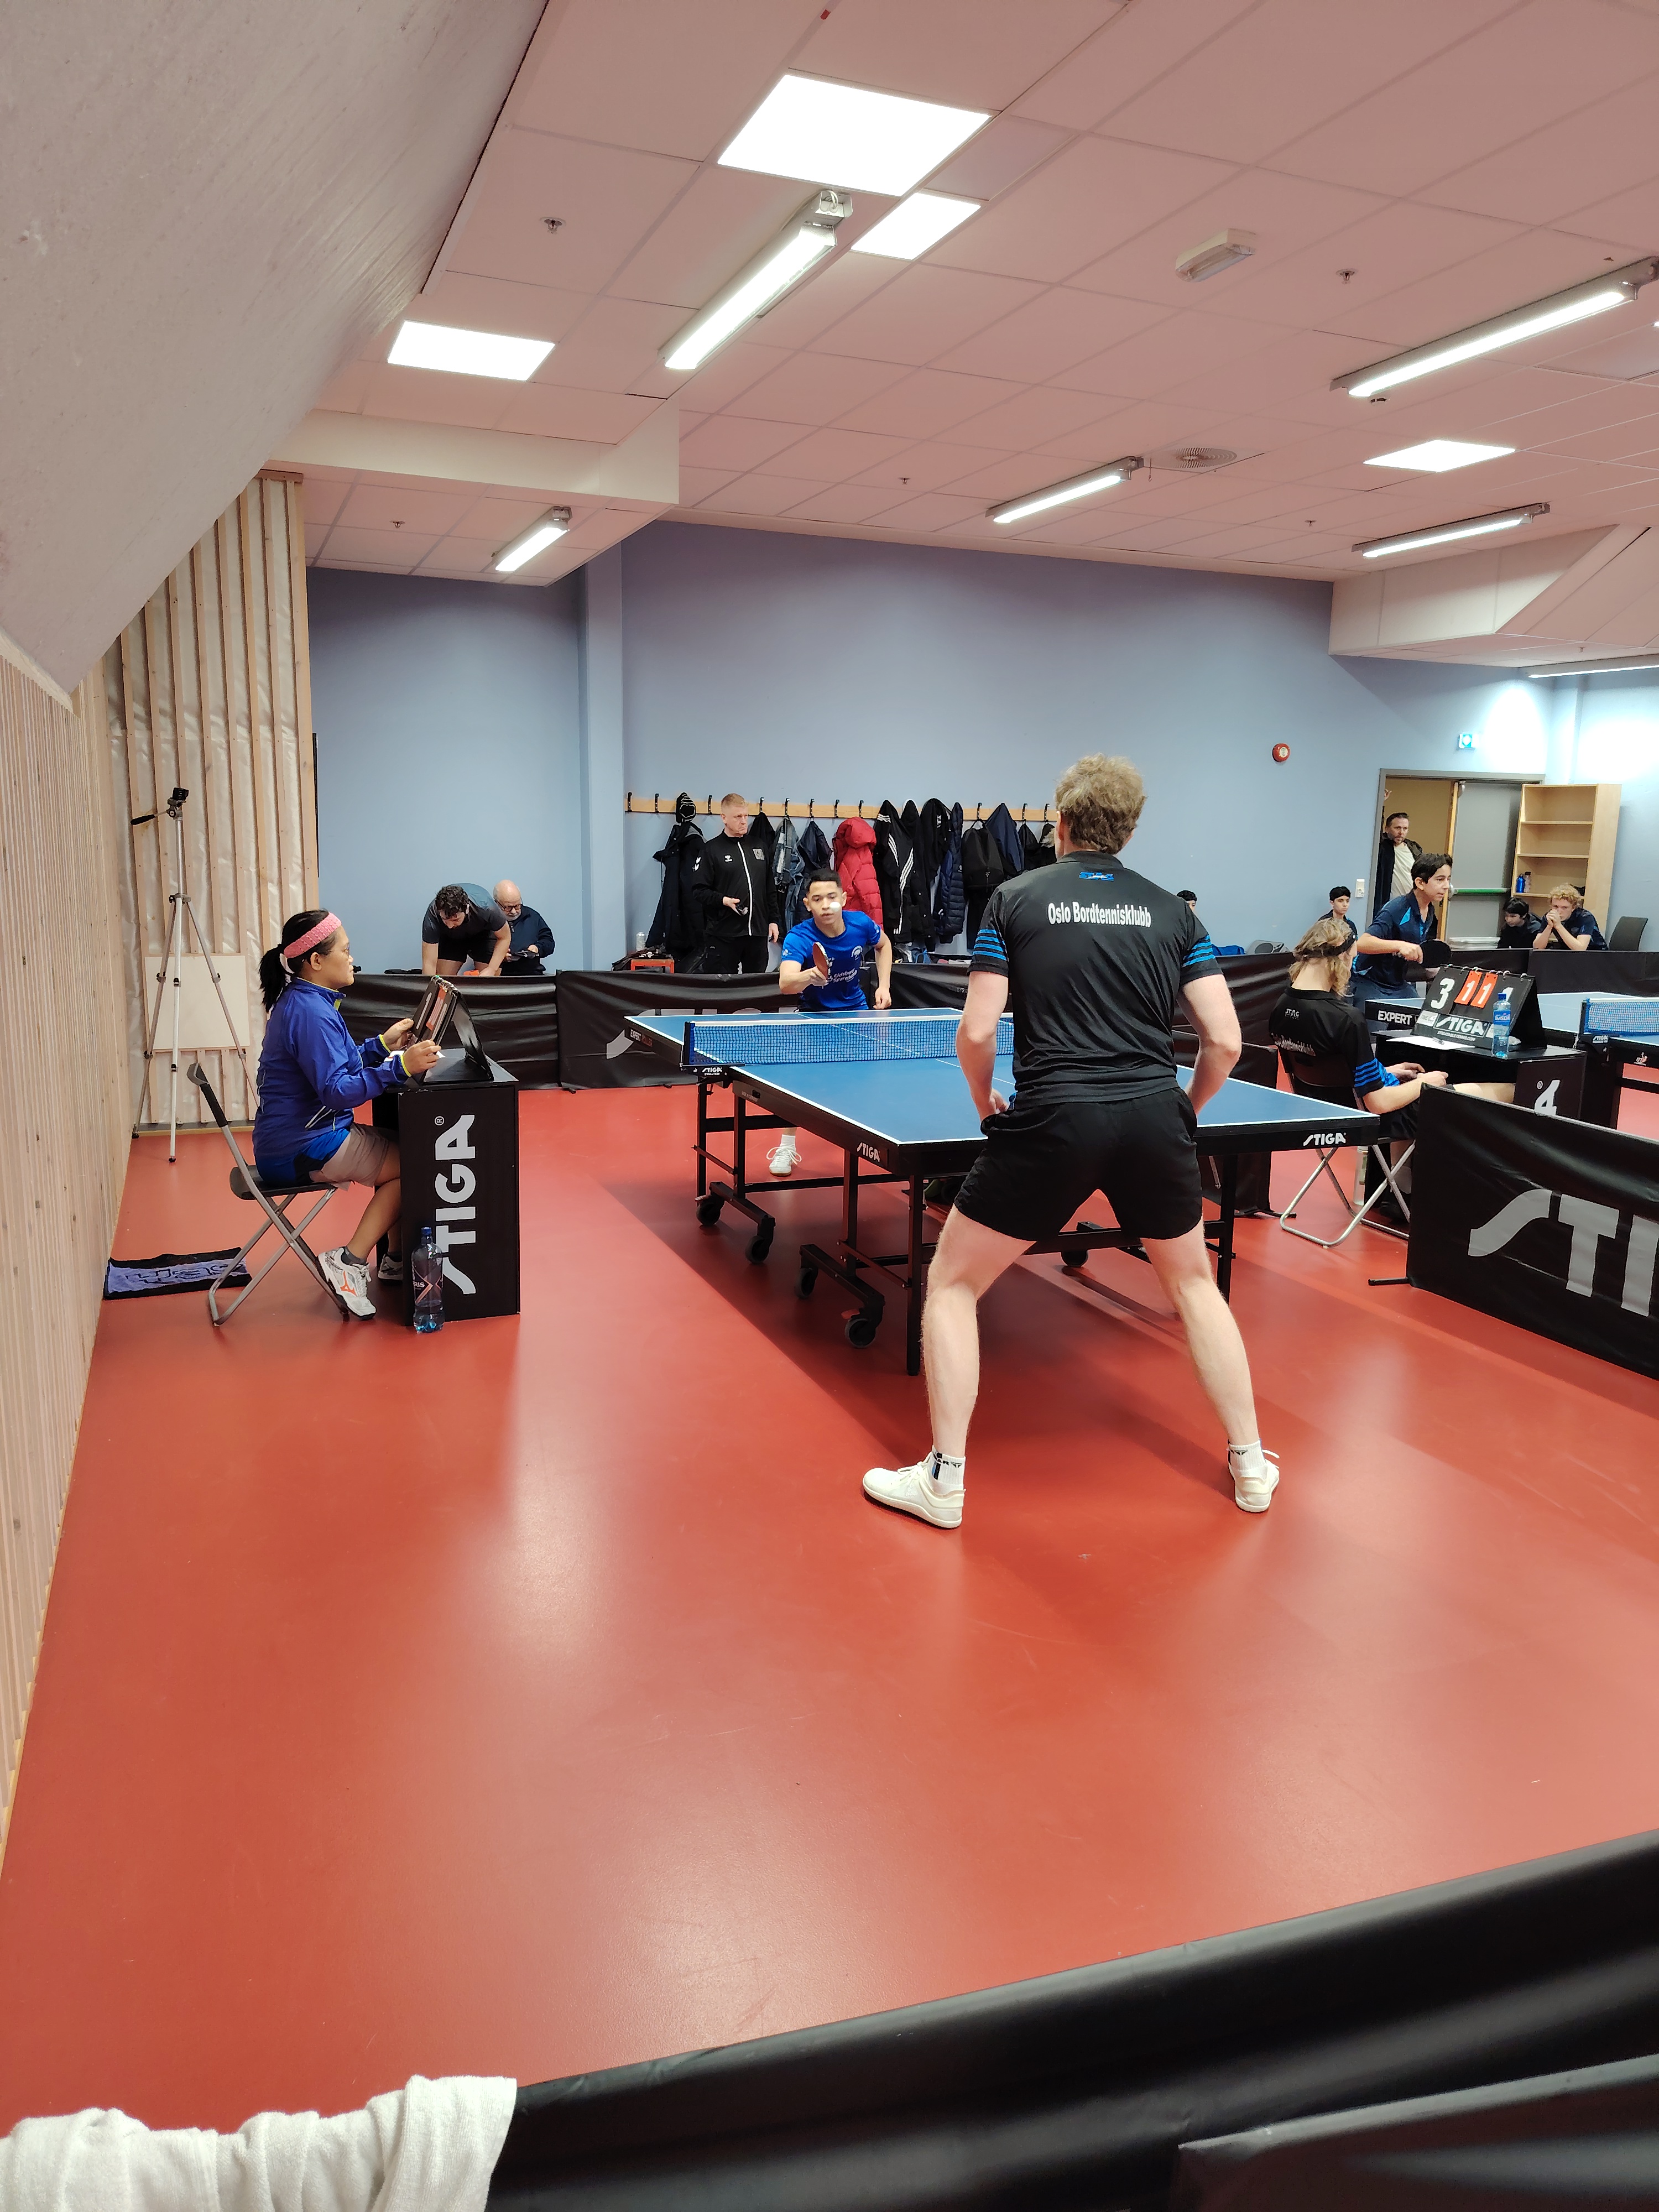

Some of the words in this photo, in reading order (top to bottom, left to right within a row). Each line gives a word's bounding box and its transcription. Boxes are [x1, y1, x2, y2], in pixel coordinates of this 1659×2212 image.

[1047, 901, 1072, 925] Oslo
[1072, 901, 1151, 928] Bordtennisklubb
[1431, 978, 1455, 1009] 3
[1462, 980, 1475, 1001] 1
[1477, 983, 1492, 1005] 1
[1378, 1010, 1413, 1025] EXPERT
[1436, 1016, 1485, 1036] STIGA
[1303, 1133, 1346, 1146] STIGA
[857, 1142, 880, 1163] STIGA
